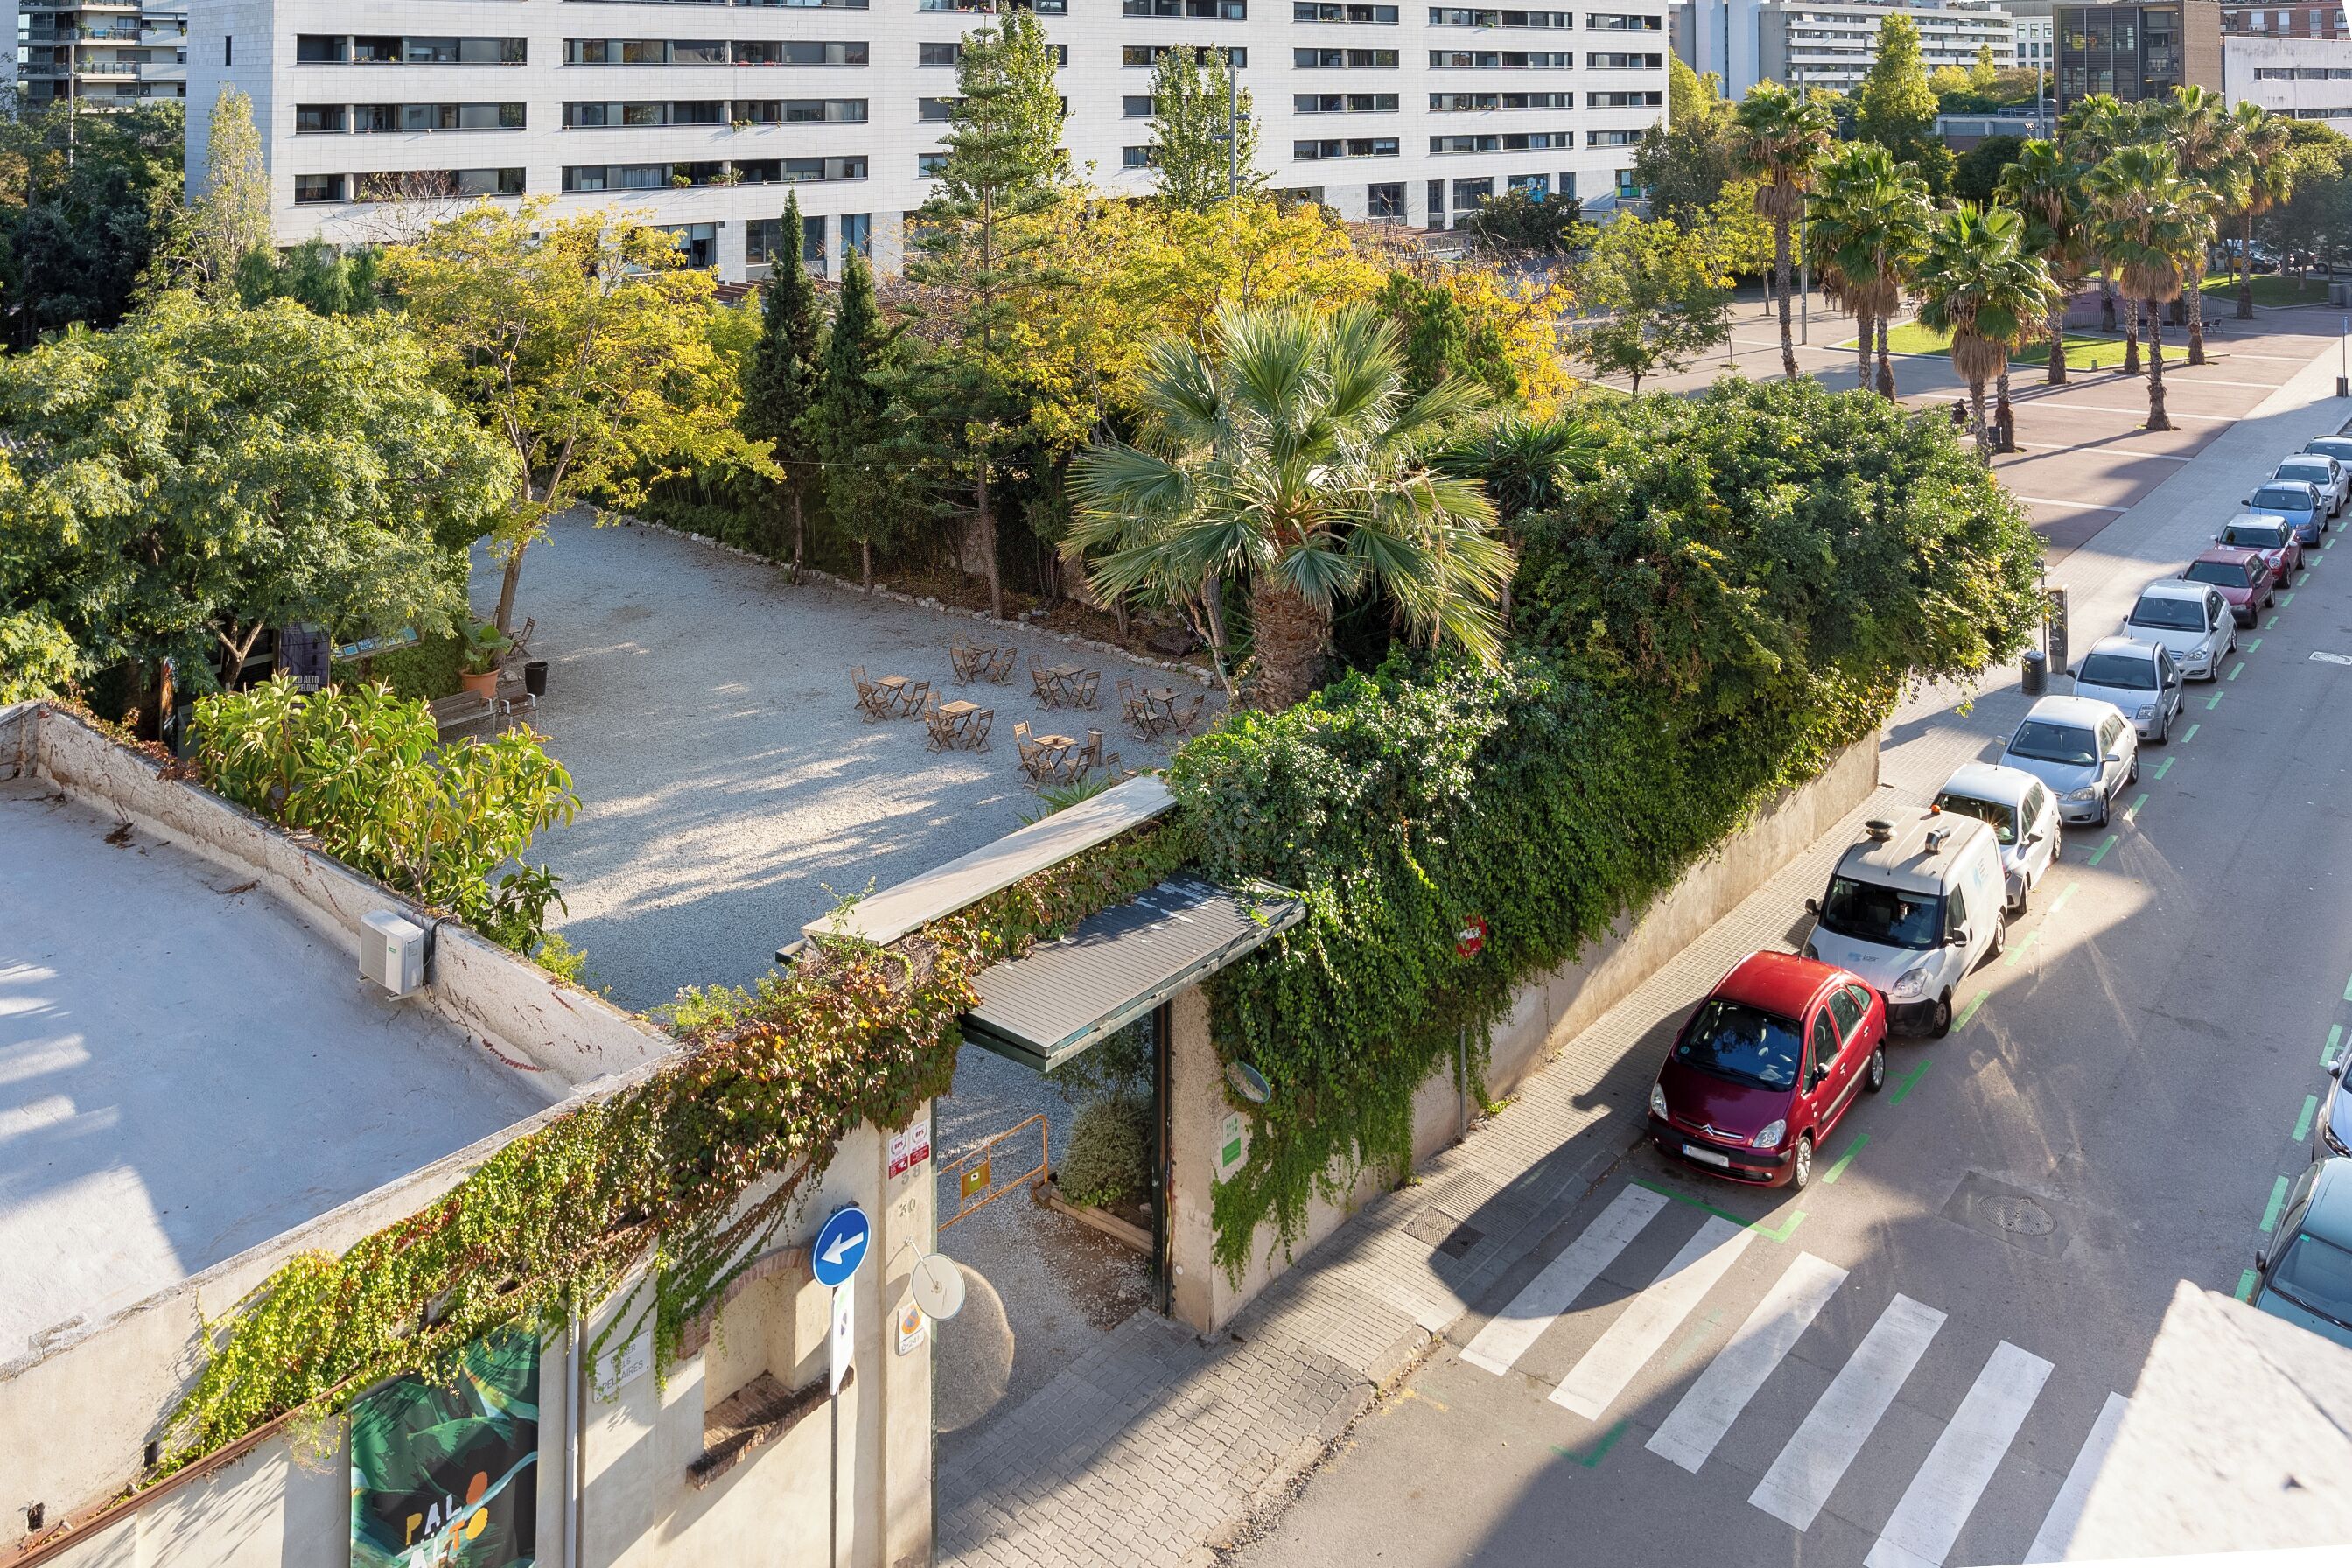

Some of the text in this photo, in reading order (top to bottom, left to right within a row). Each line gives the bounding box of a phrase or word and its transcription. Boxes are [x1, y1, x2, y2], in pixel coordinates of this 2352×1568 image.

[304, 676, 319, 684] ALTO
[602, 1359, 644, 1391] PELAIRES
[405, 1471, 489, 1546] PALO
[407, 1507, 489, 1568] ALTO
